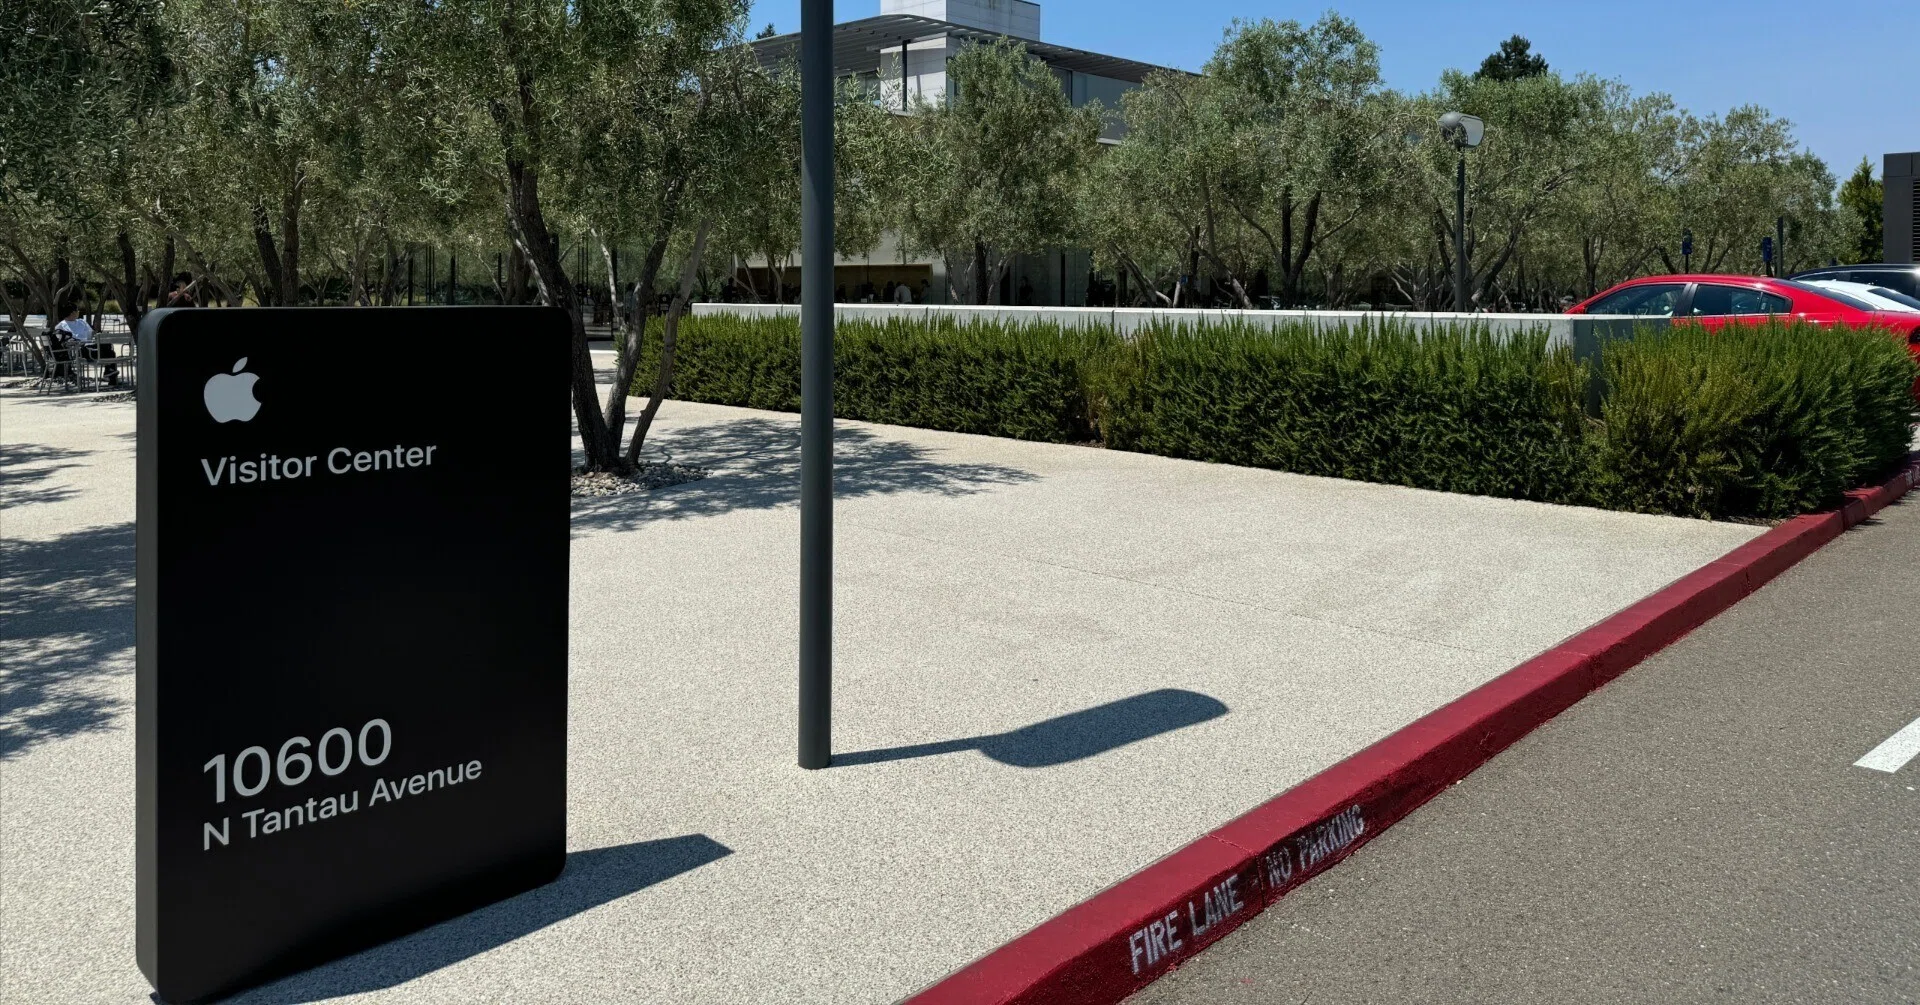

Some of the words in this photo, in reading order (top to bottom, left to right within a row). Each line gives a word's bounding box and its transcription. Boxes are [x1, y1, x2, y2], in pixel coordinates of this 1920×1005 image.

[201, 454, 318, 486] Visitor
[328, 444, 437, 475] Center
[203, 718, 392, 804] 10600
[203, 817, 230, 851] N
[241, 790, 359, 839] Tantau
[368, 759, 482, 807] Avenue
[1129, 910, 1182, 975] FIRE
[1188, 873, 1244, 937] LANE
[1266, 846, 1292, 888] NO
[1297, 804, 1365, 871] PARKING
